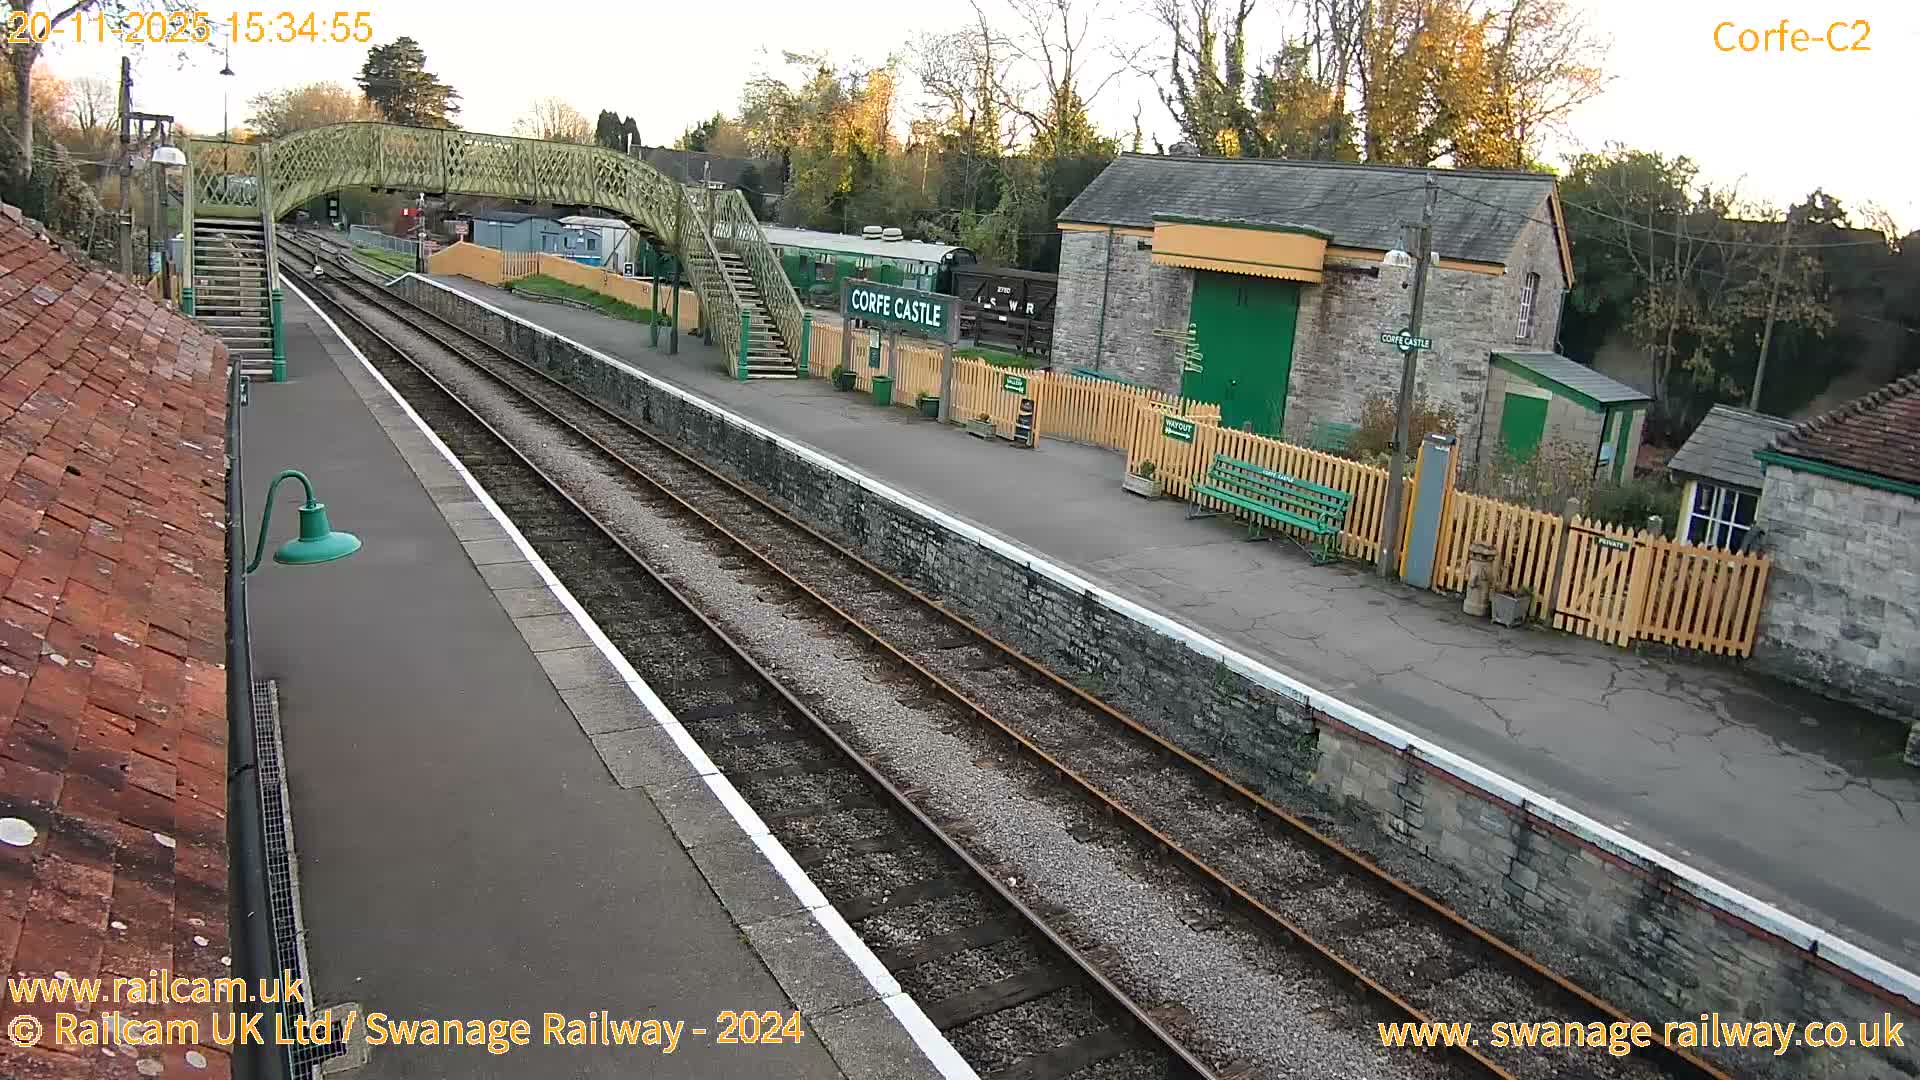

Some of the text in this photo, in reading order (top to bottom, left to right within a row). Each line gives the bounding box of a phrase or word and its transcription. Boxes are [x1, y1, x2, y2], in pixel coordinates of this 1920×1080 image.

[852, 289, 941, 327] CORFE CASTLE
[1025, 302, 1035, 315] R
[1382, 334, 1430, 348] CORFE CASTLE
